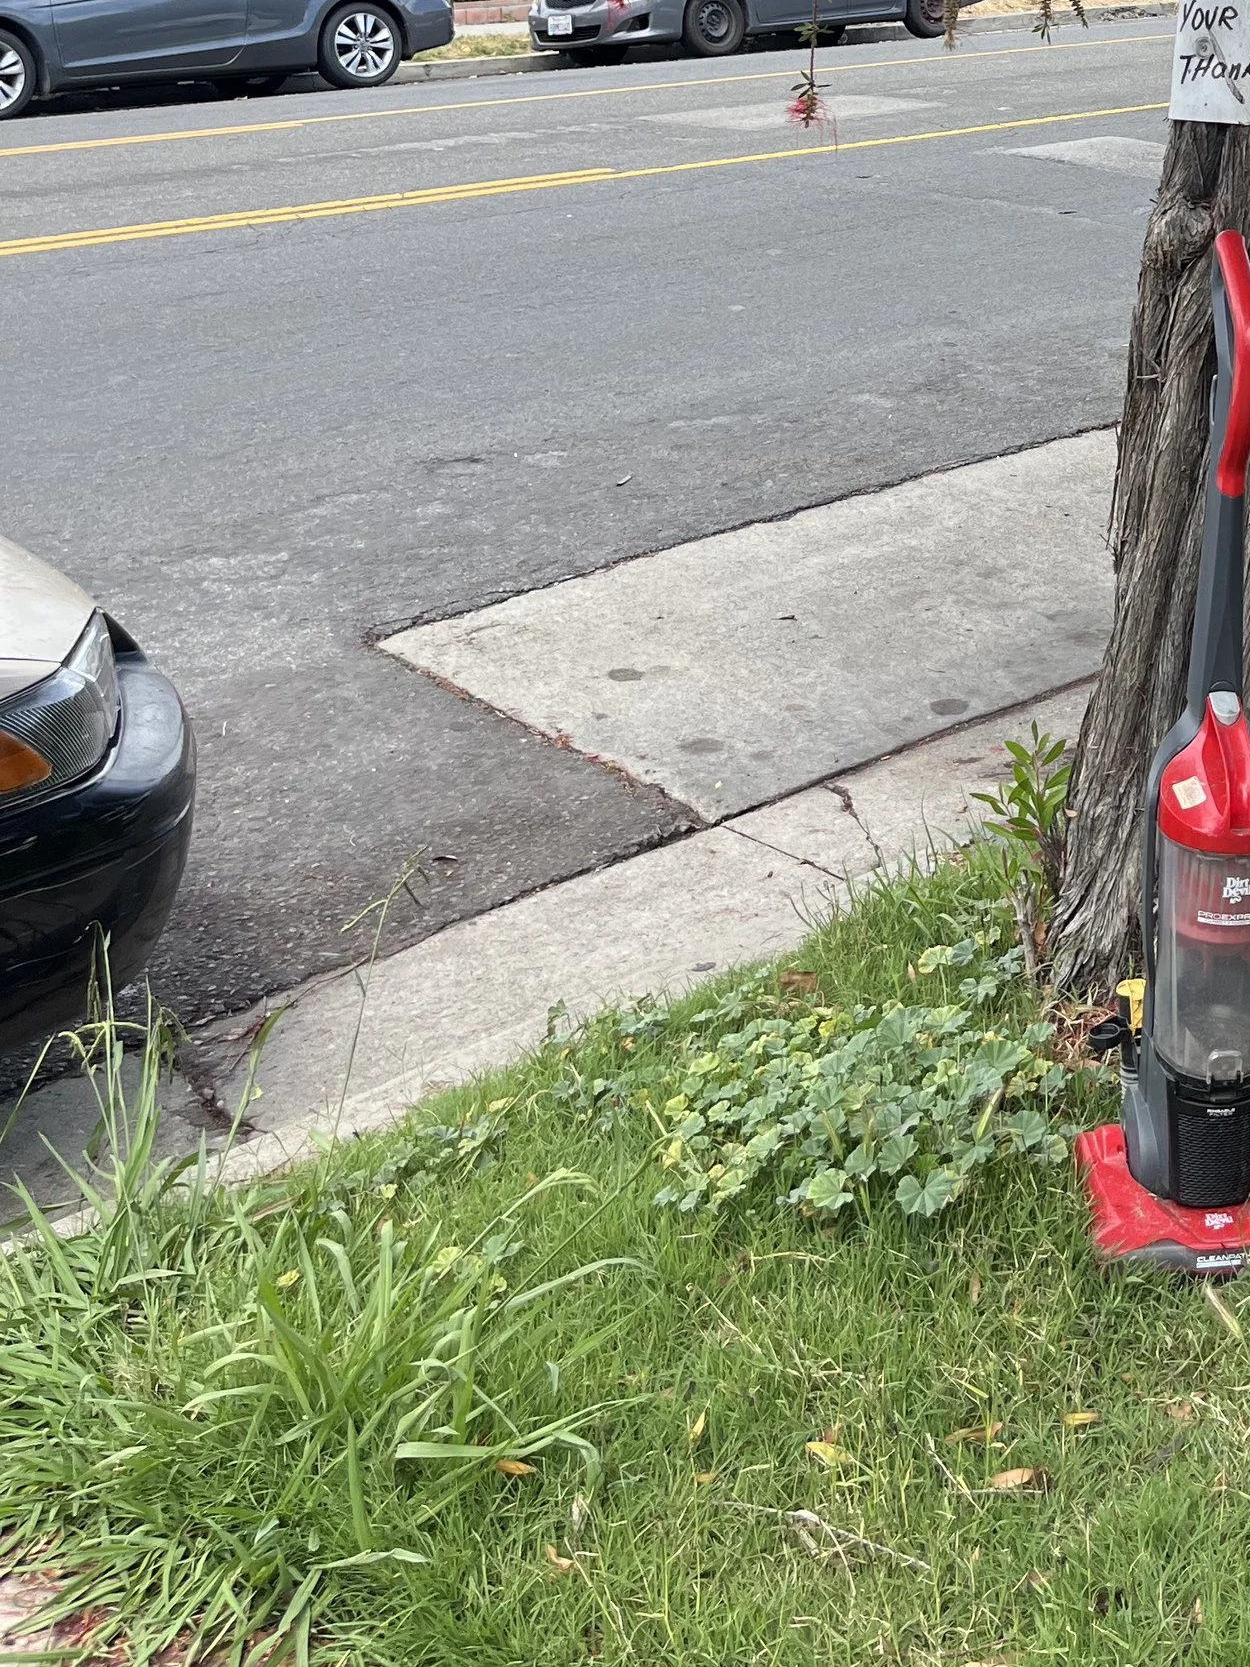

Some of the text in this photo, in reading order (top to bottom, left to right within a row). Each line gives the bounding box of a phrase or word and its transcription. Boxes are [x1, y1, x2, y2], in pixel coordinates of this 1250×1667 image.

[1226, 877, 1250, 888] Dirt
[1205, 1213, 1227, 1221] Dirt
[1205, 1215, 1234, 1227] Devil
[1197, 1252, 1249, 1263] CLEANPAT
